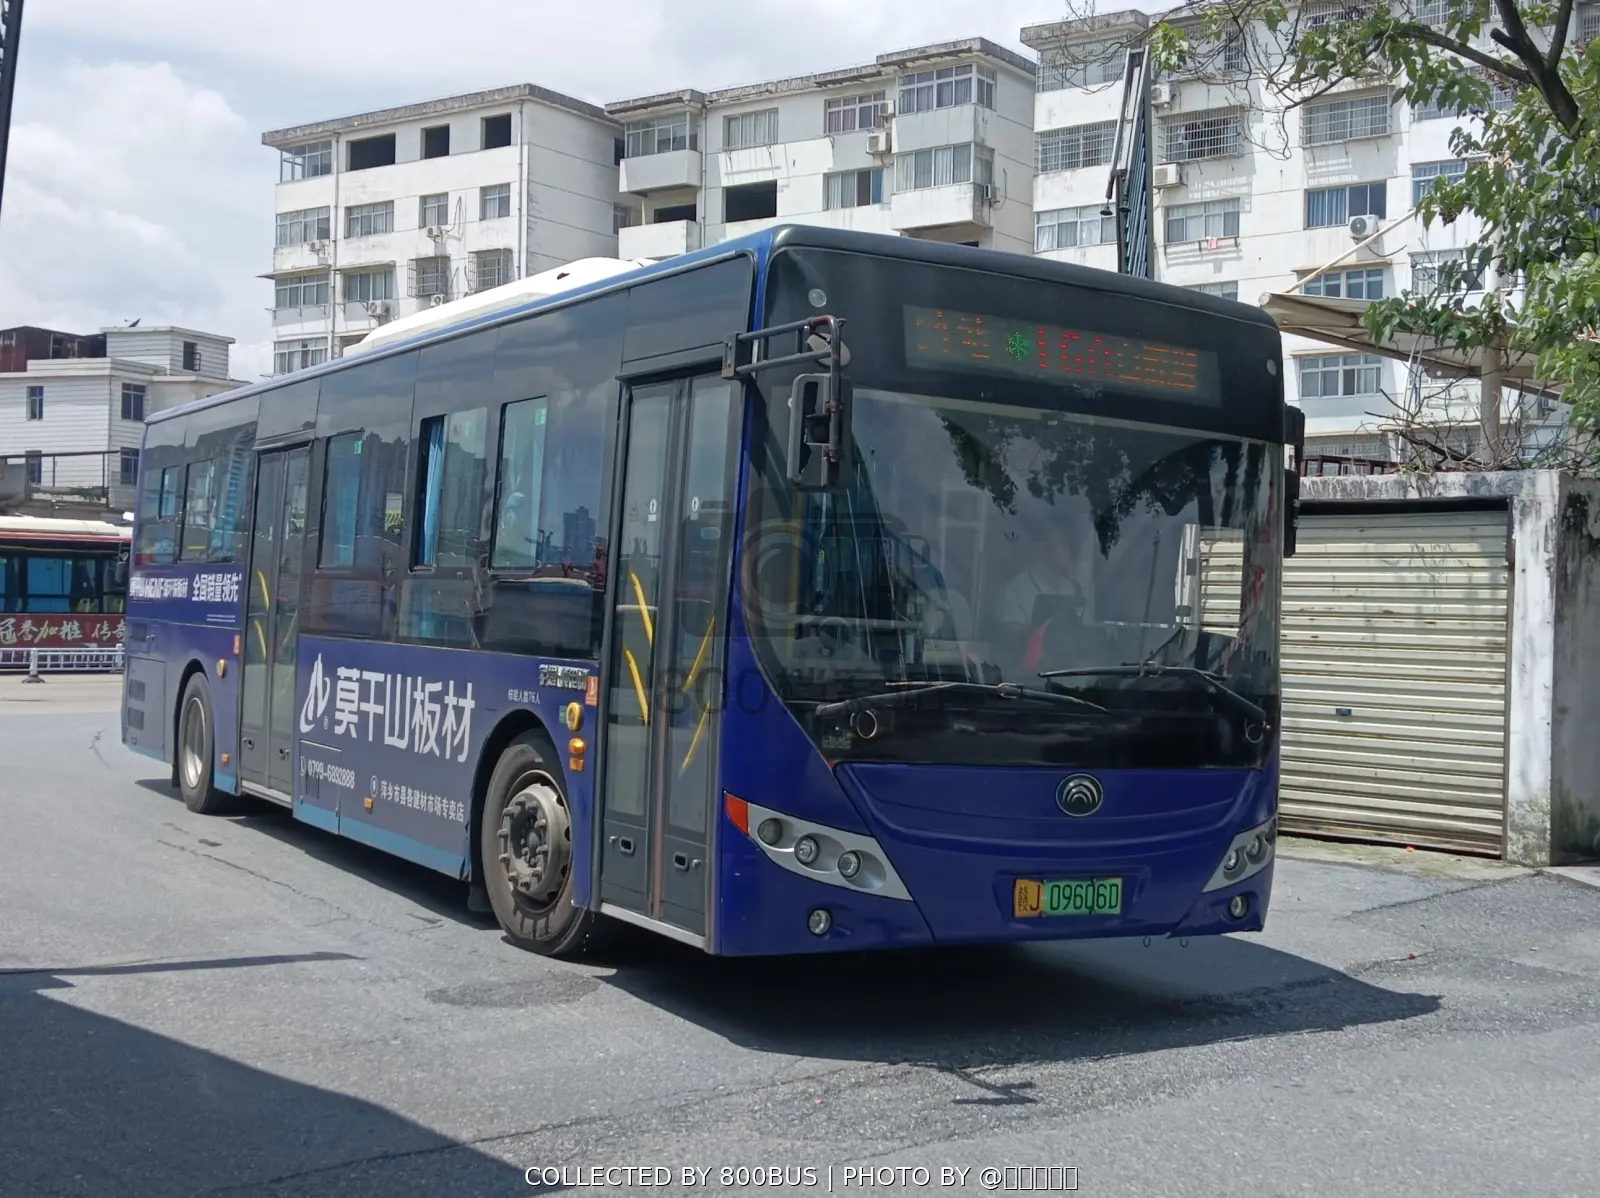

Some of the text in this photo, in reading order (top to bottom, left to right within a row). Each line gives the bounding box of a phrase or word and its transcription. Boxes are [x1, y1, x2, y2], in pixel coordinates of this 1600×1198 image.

[334, 666, 475, 763] 莫干山板材
